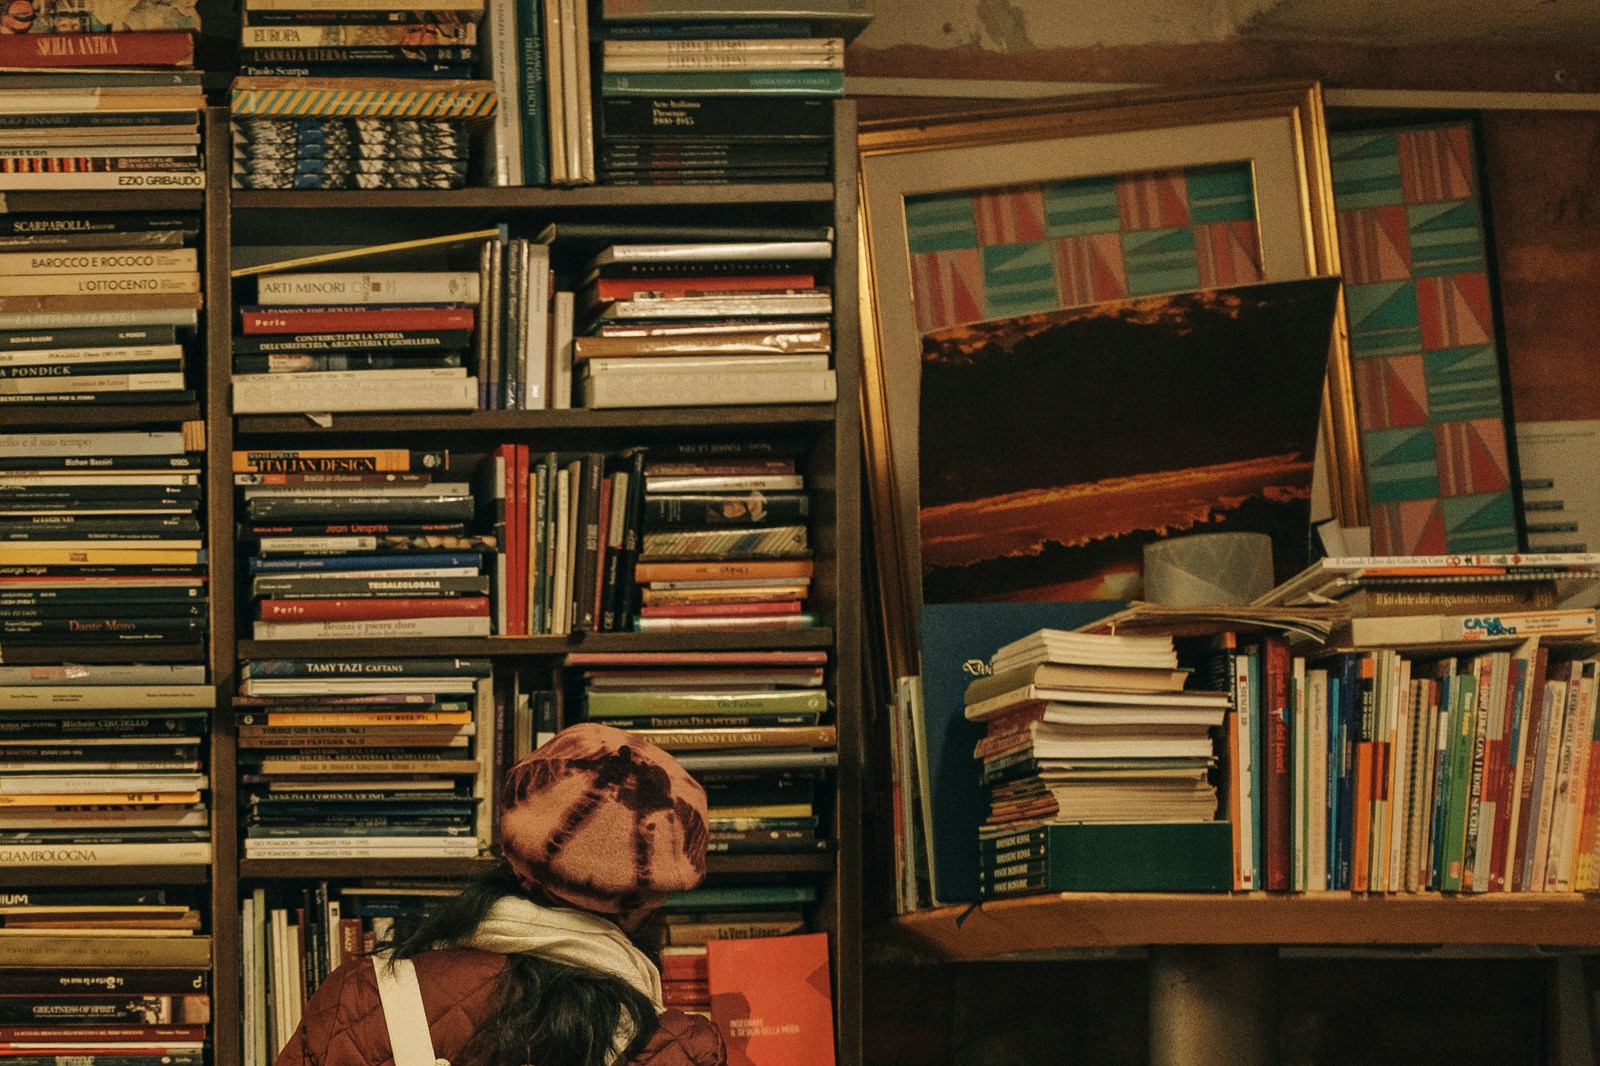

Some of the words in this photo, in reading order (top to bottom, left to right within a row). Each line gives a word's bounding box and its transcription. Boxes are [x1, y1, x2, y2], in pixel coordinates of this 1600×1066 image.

[254, 28, 300, 42] EUROPA
[79, 36, 119, 54] ANTICA
[118, 176, 143, 186] EZIO
[145, 175, 201, 186] GRIBAUDO
[13, 220, 91, 231] SCARPABOLLA
[31, 256, 90, 269] BAROCCO
[91, 257, 98, 267] E
[101, 255, 154, 267] ROCOCO
[79, 279, 158, 291] L'OTTOCENTO
[263, 282, 293, 293] ARTI
[295, 282, 346, 293] MINORI
[255, 318, 287, 327] Perle
[372, 333, 404, 341] STORIA
[11, 366, 71, 377] PONDICK
[59, 438, 93, 449] tempo
[257, 459, 318, 472] ITALIAN
[320, 458, 374, 471] DESIGN
[367, 581, 441, 589] TRIBALEGLOBALE
[273, 606, 305, 614] Perle
[68, 620, 102, 631] Dante
[392, 621, 417, 630] dure
[1463, 618, 1504, 630] CASA
[306, 663, 337, 673] TAMY
[338, 663, 363, 672] TAZI
[366, 665, 404, 673] CAFTANS
[32, 1005, 79, 1014] GREATNESS
[91, 1005, 116, 1013] SPIRIT
